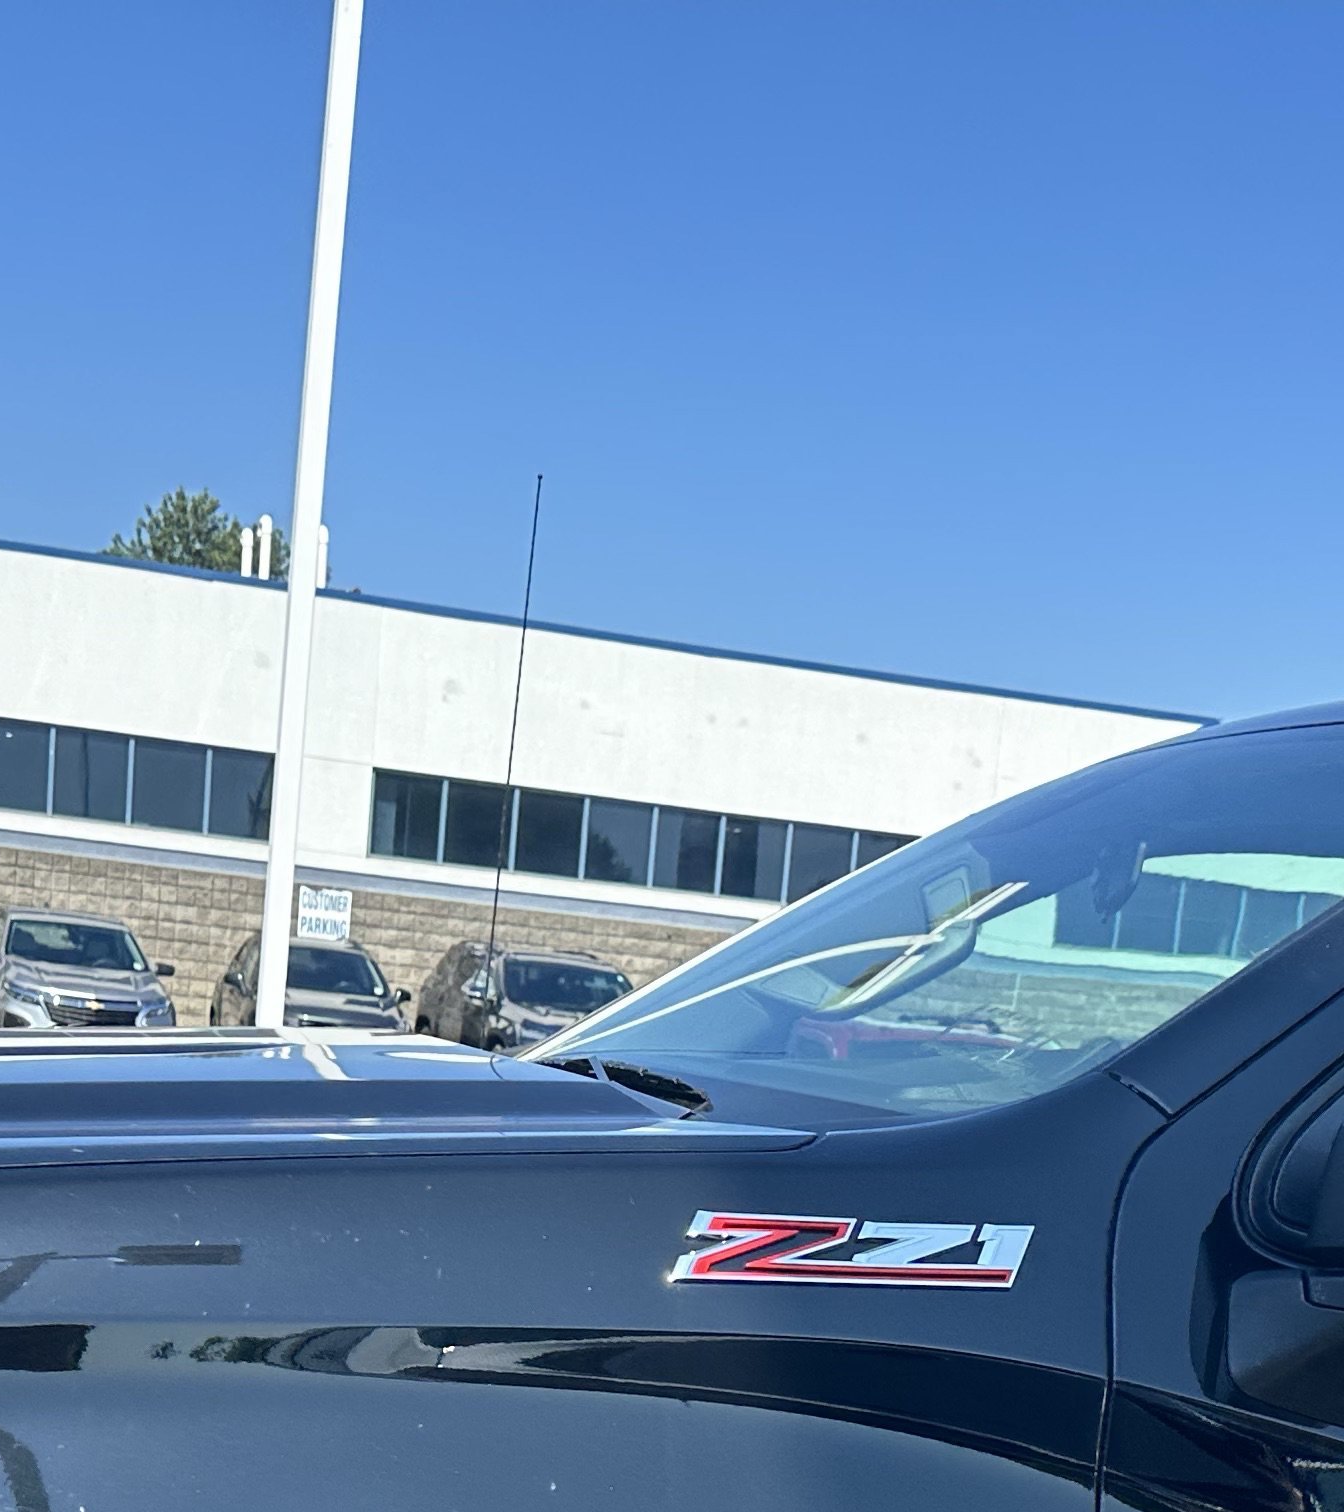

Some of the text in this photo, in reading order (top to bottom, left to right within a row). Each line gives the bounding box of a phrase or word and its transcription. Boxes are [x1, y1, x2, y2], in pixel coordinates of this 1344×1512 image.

[302, 891, 348, 912] CUSTOMER
[301, 916, 346, 936] PARKING
[666, 1208, 1036, 1289] Z71
